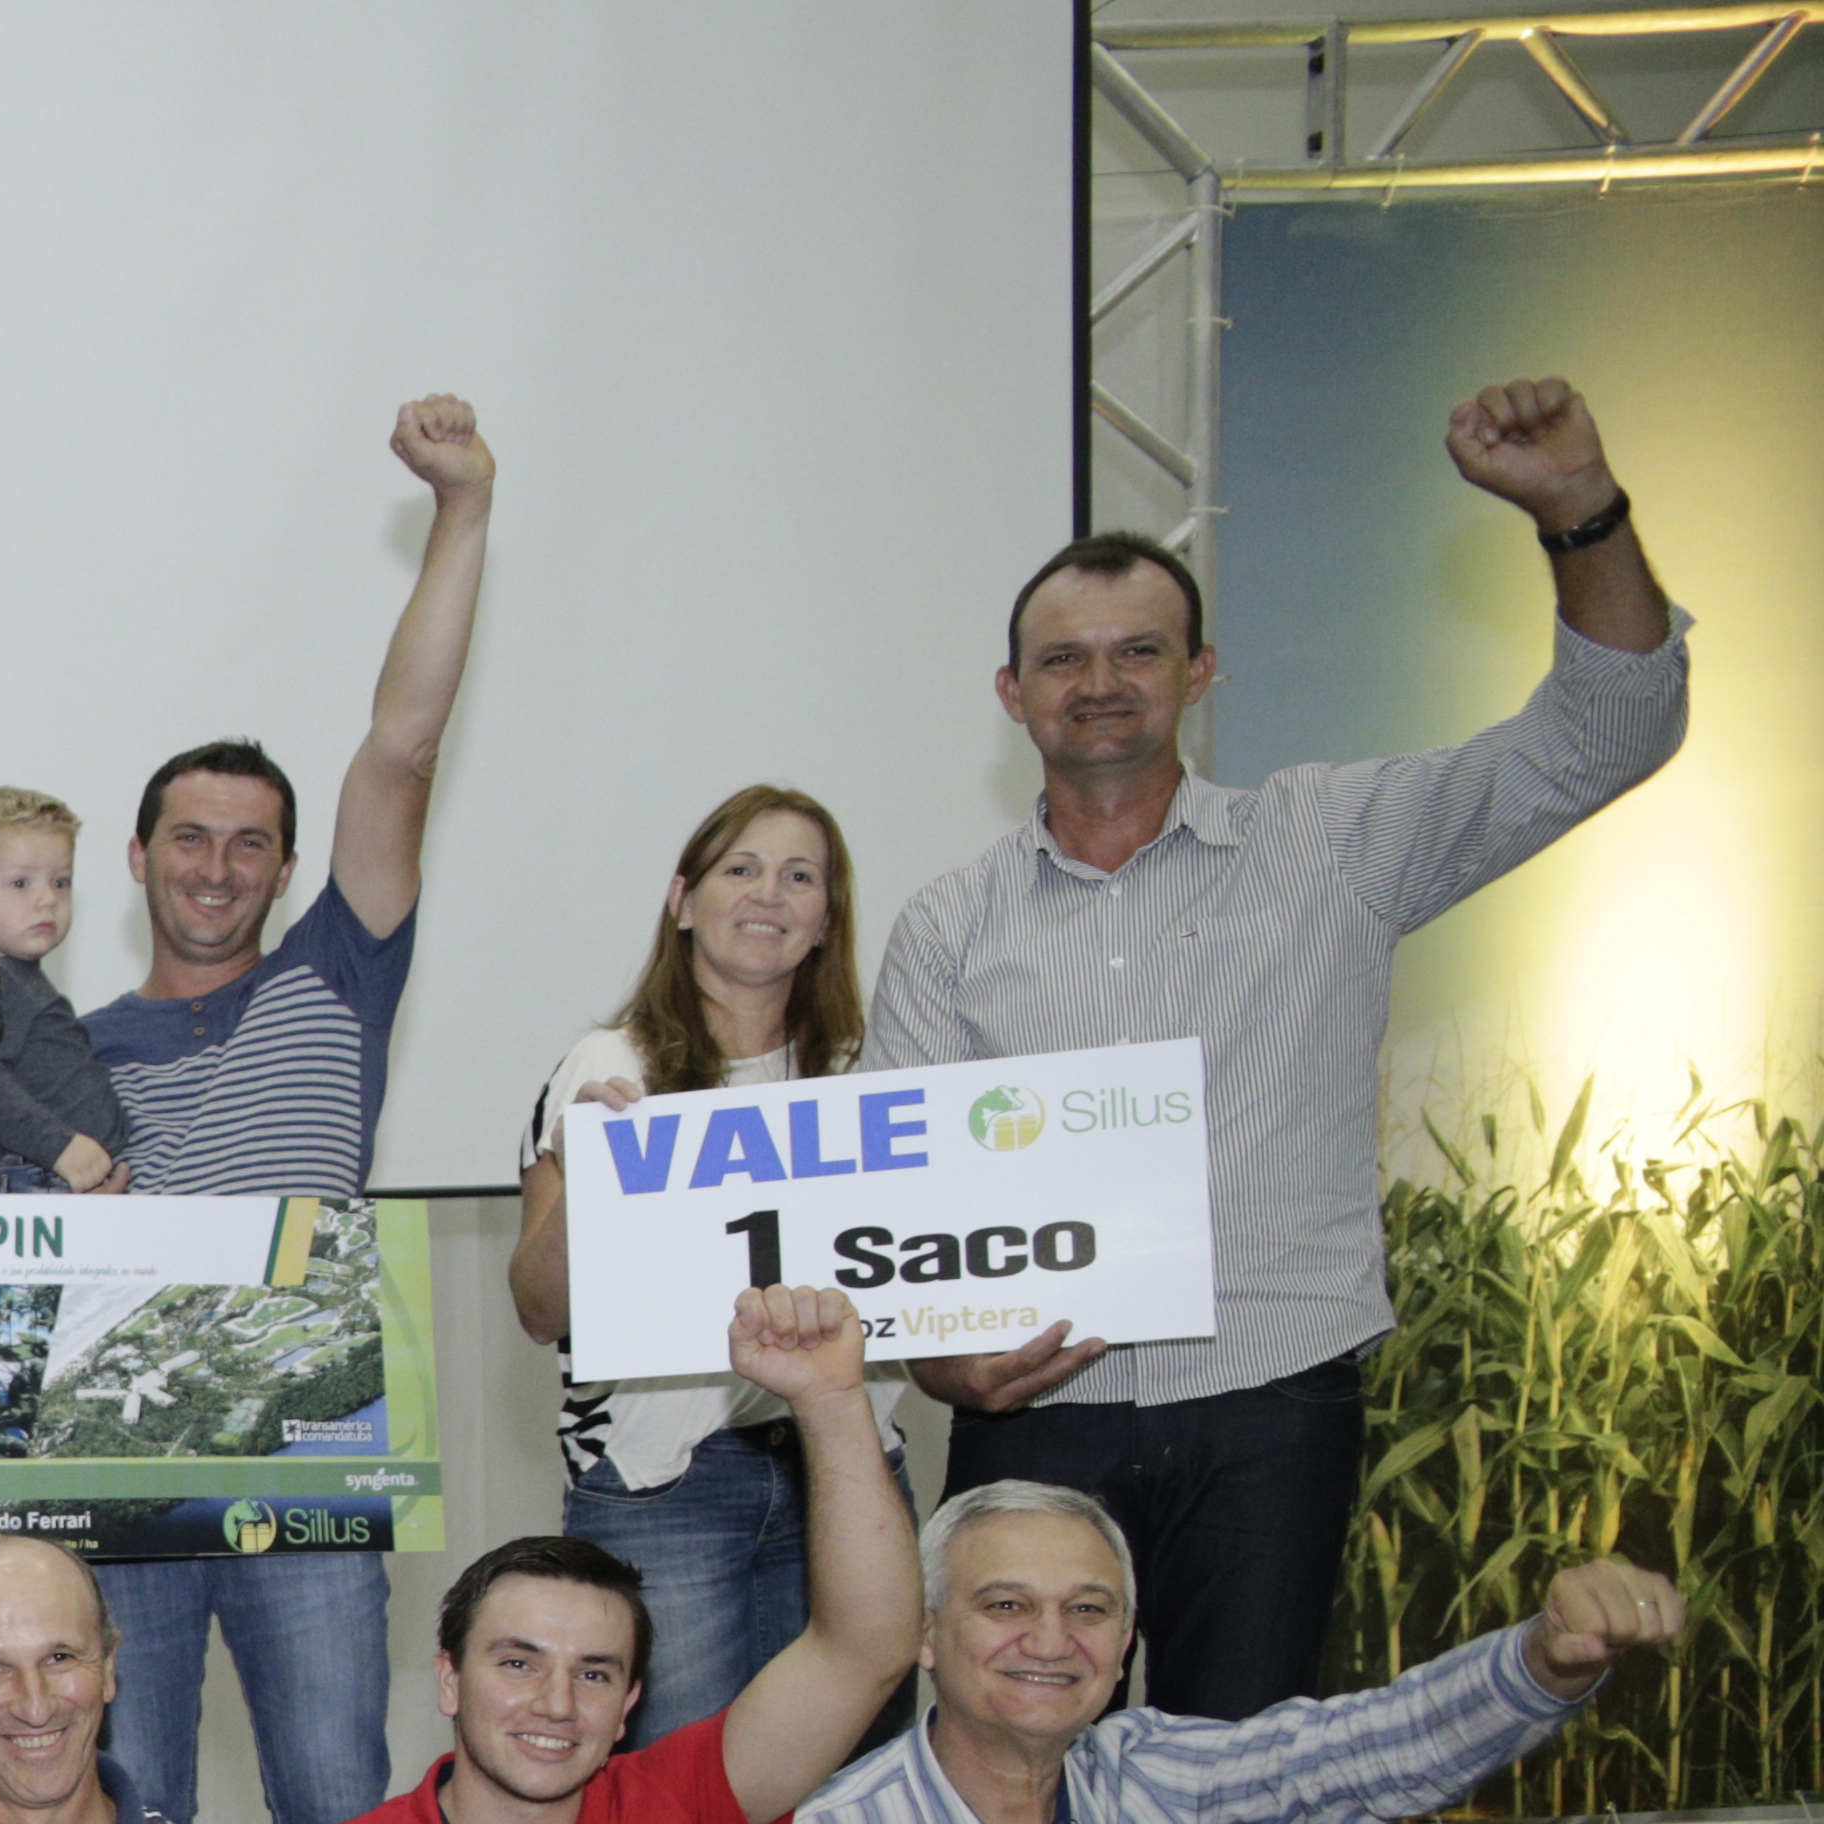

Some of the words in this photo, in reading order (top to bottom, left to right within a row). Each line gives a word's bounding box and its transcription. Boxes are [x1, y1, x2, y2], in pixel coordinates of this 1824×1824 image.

[603, 1088, 929, 1195] VALE
[1061, 1087, 1192, 1134] Sillus
[725, 1209, 782, 1288] 1
[833, 1220, 1096, 1289] Saco
[901, 1306, 1039, 1342] Viptera
[27, 1511, 91, 1530] Ferrari
[284, 1508, 370, 1545] Sillus
